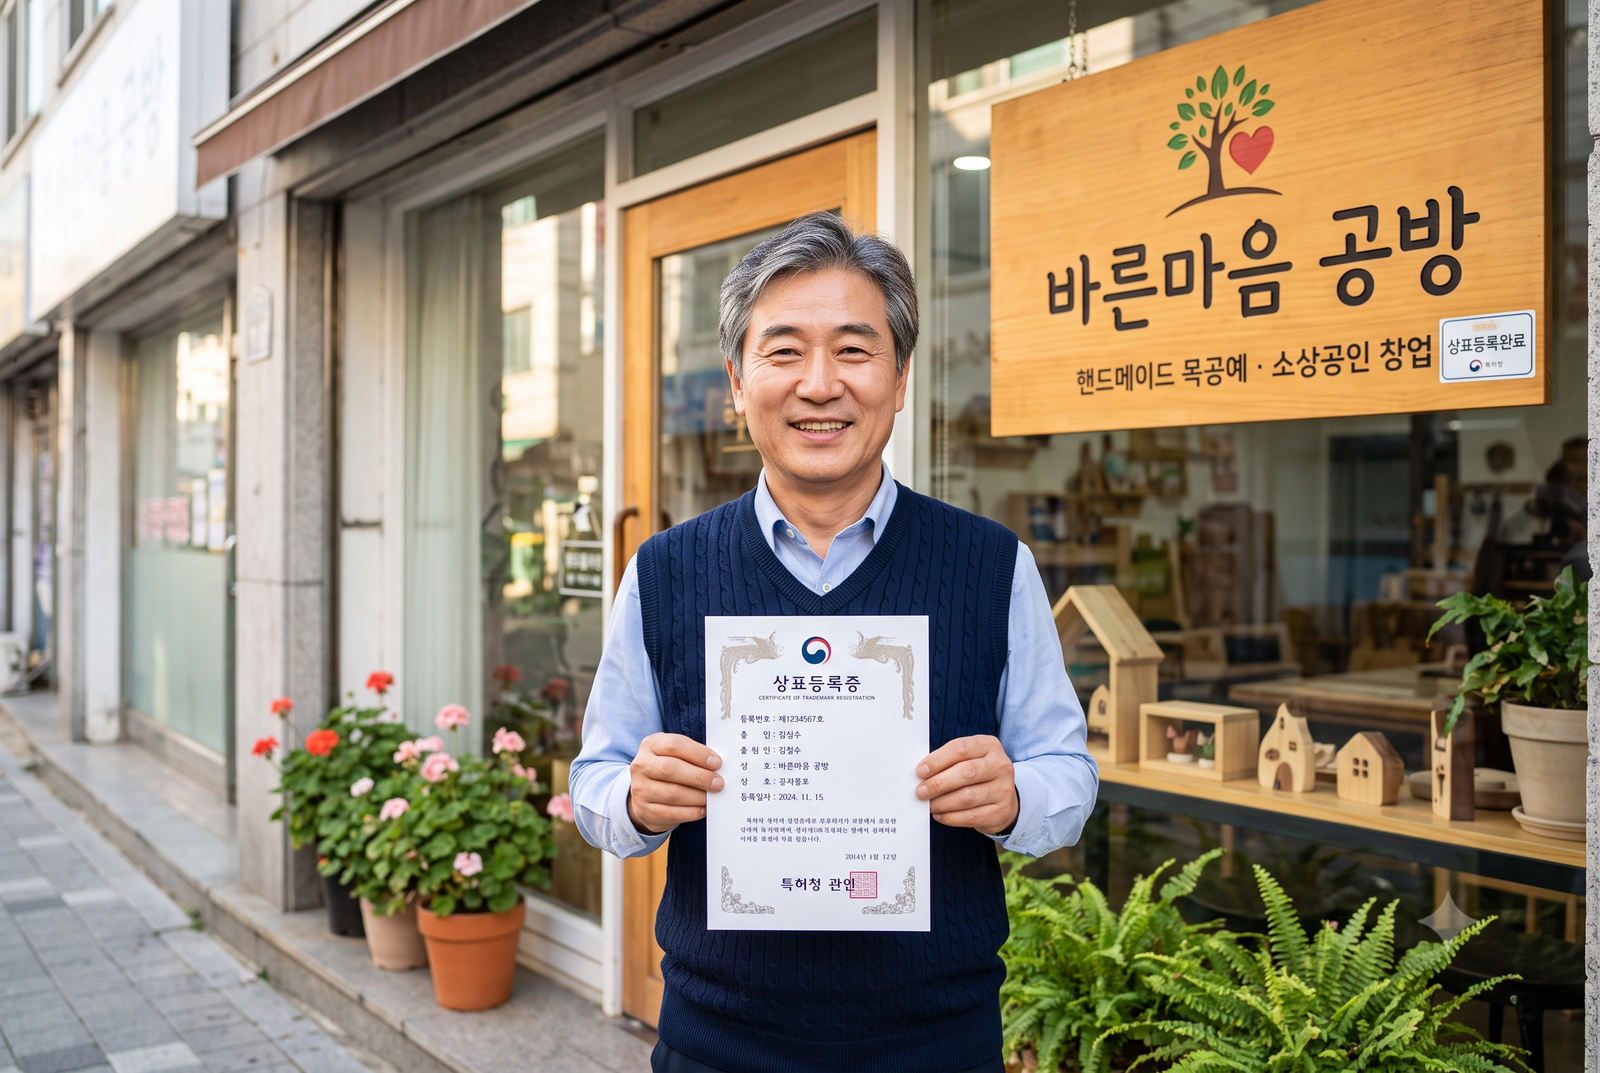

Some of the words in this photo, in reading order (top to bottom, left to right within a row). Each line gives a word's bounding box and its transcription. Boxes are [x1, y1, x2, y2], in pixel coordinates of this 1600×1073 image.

[1047, 218, 1293, 332] 바른마음
[1318, 185, 1481, 307] 공방
[1447, 333, 1527, 355] 상표등록완료
[1077, 362, 1175, 397] 핸드메이드
[1182, 353, 1247, 387] 목공예
[1272, 340, 1370, 378] 소상공인
[1380, 334, 1432, 372] 창업
[772, 675, 862, 693] 상표등록증
[740, 714, 771, 724] 등록번호
[778, 714, 825, 724] 제1234567호
[813, 761, 830, 771] 공방
[778, 793, 799, 802] 2024.
[801, 793, 812, 802] 11.
[815, 793, 826, 802] 15.
[780, 877, 821, 892] 특허청
[828, 877, 856, 892] 관인
